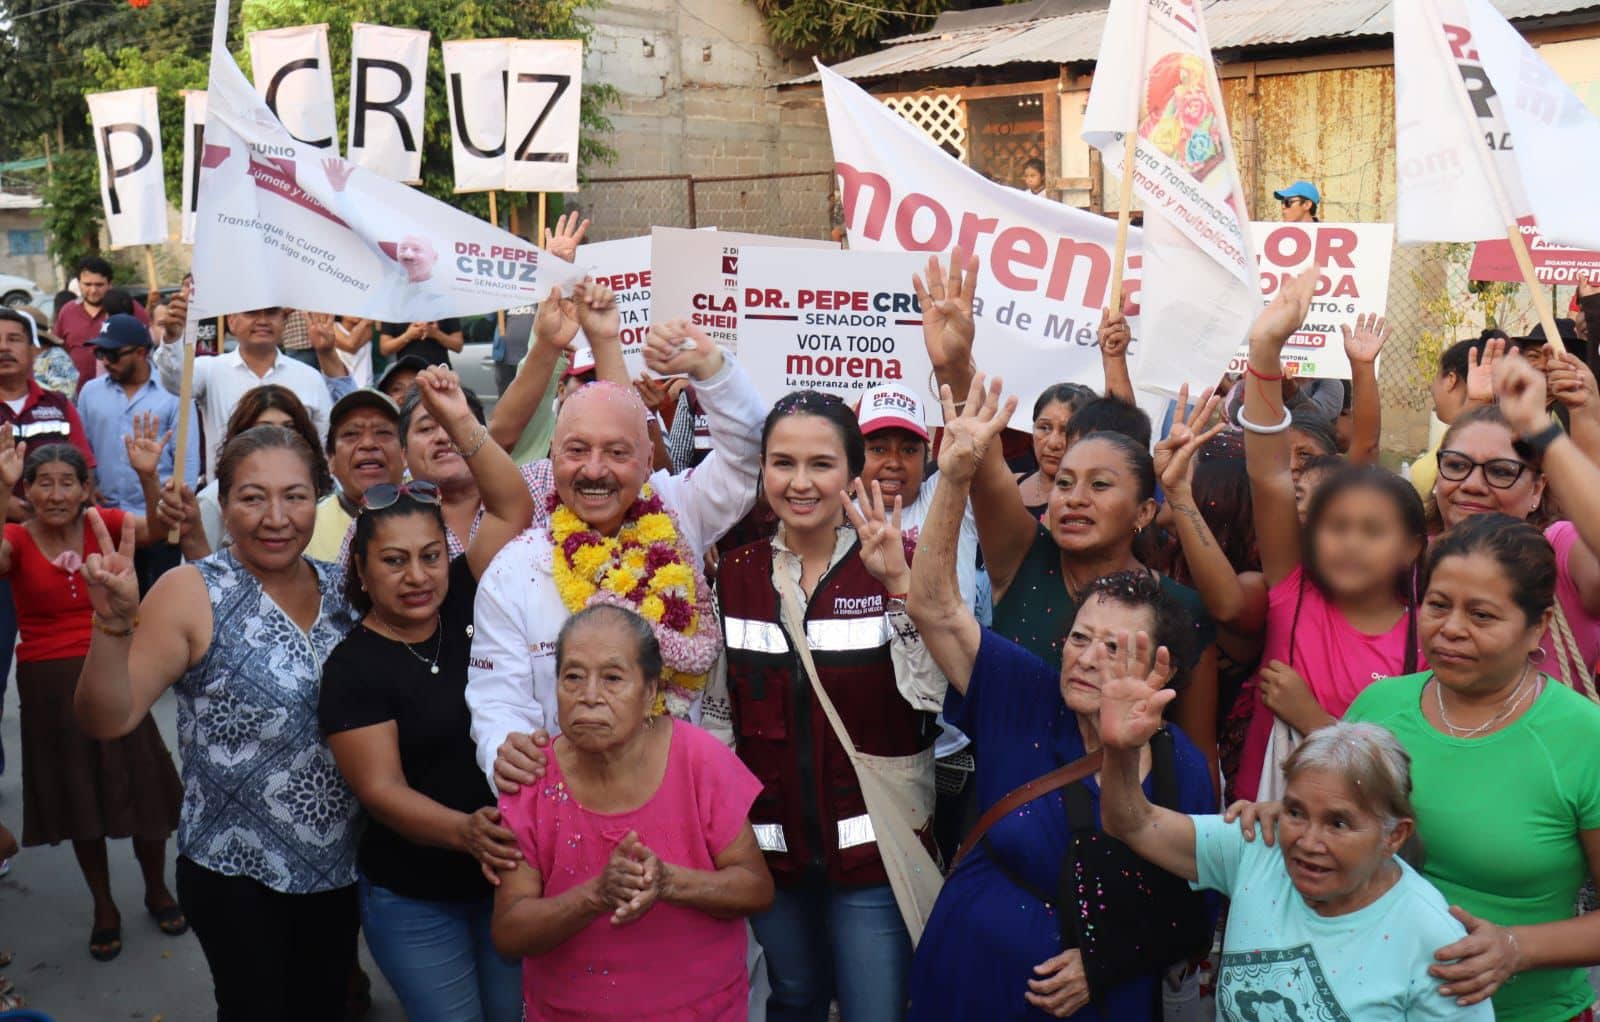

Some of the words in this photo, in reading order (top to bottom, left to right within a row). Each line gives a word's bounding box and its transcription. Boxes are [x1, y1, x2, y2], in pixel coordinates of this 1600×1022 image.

[253, 167, 291, 191] úmate
[296, 238, 336, 262] Cuarta
[455, 242, 486, 257] DR.
[490, 245, 538, 264] PEPE
[730, 247, 739, 255] D
[1256, 226, 1358, 269] OR
[280, 243, 300, 258] siga
[301, 255, 315, 266] en
[317, 261, 371, 292] Chiapas!
[456, 256, 538, 283] CRUZ
[745, 287, 790, 309] DR.
[797, 289, 869, 312] PEPE
[873, 292, 925, 313] CRU
[1346, 303, 1355, 314] 6
[805, 313, 887, 328] SENADOR
[995, 300, 1033, 331] de
[1299, 323, 1336, 334] ANZA
[797, 334, 842, 351] VOTA
[847, 335, 895, 354] TODO
[786, 354, 903, 380] morena
[786, 376, 797, 387] La
[799, 378, 850, 390] esperanza
[852, 380, 864, 389] de
[834, 594, 882, 609] morena
